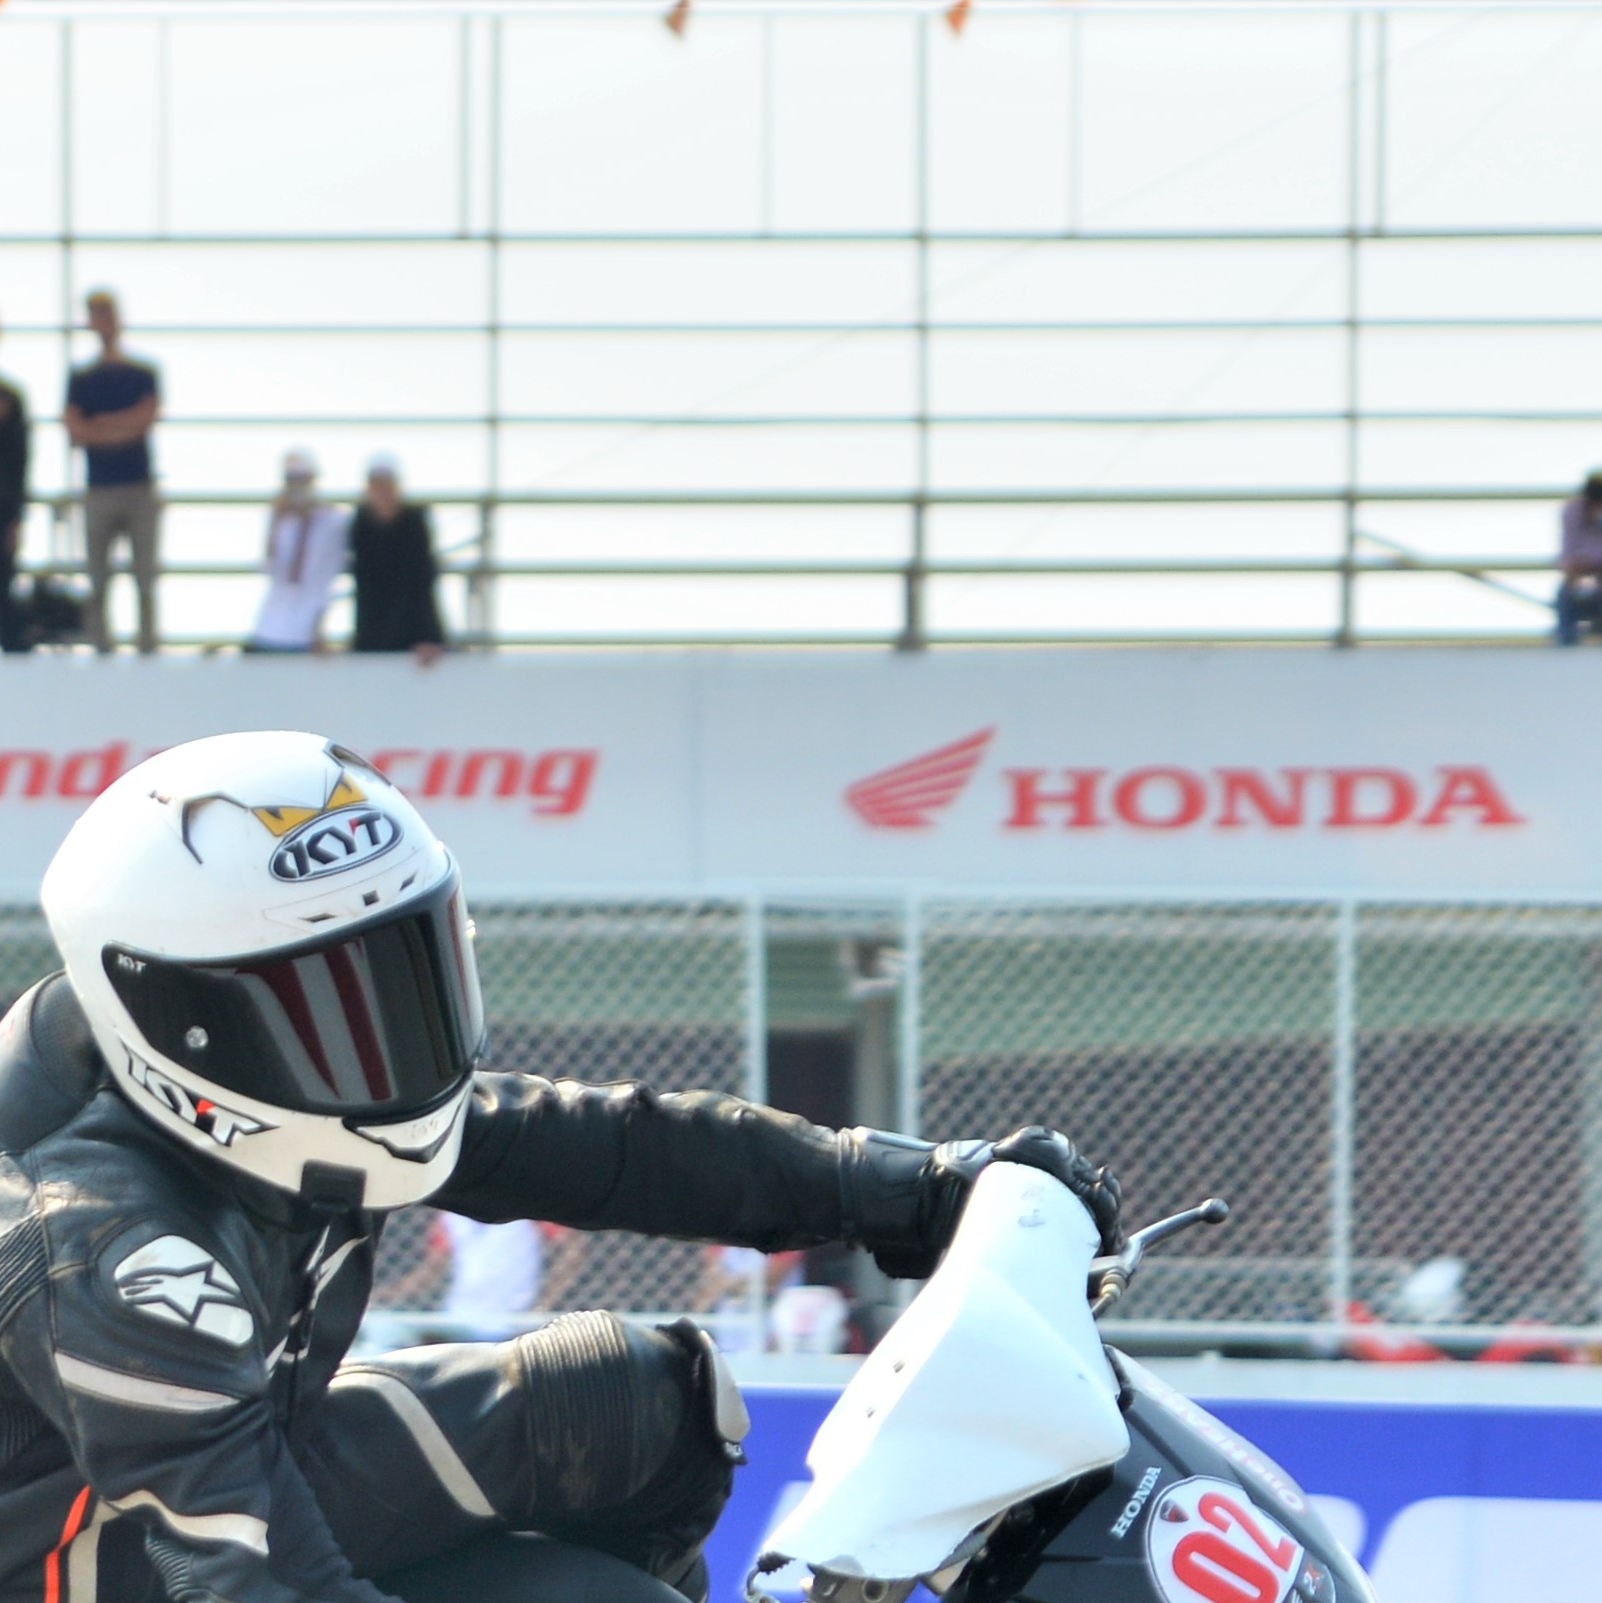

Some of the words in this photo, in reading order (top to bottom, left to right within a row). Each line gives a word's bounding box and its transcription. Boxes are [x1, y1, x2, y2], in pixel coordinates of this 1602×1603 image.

[368, 748, 599, 819] cing
[1002, 766, 1526, 833] HONDA
[285, 810, 385, 878] KYT
[121, 1043, 281, 1147] KYT
[1110, 1466, 1162, 1540] HONDA
